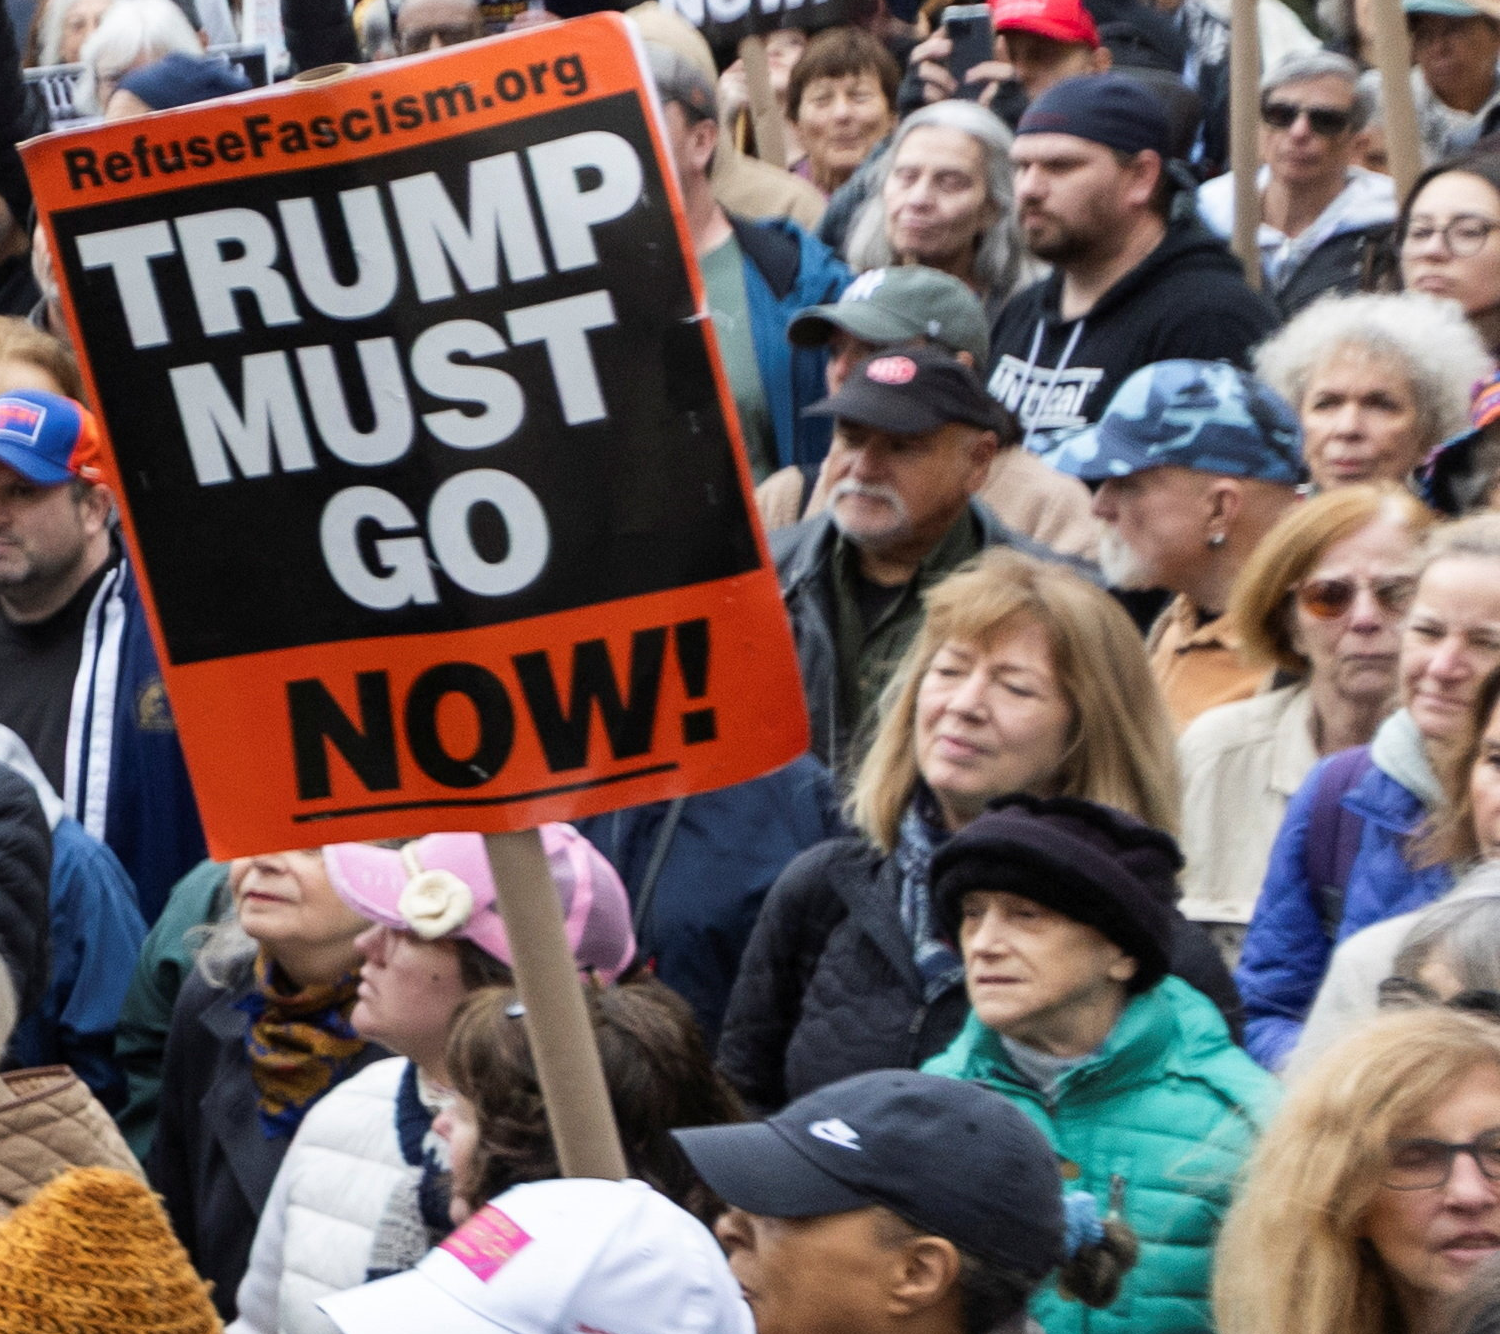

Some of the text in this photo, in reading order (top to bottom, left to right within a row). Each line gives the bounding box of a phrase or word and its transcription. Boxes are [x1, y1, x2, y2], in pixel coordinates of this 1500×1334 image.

[65, 49, 590, 192] RefuseFascism.org
[74, 129, 646, 353] TRUMP
[166, 289, 619, 489] MUST
[318, 467, 552, 613] GO
[284, 616, 719, 804] NOW!
